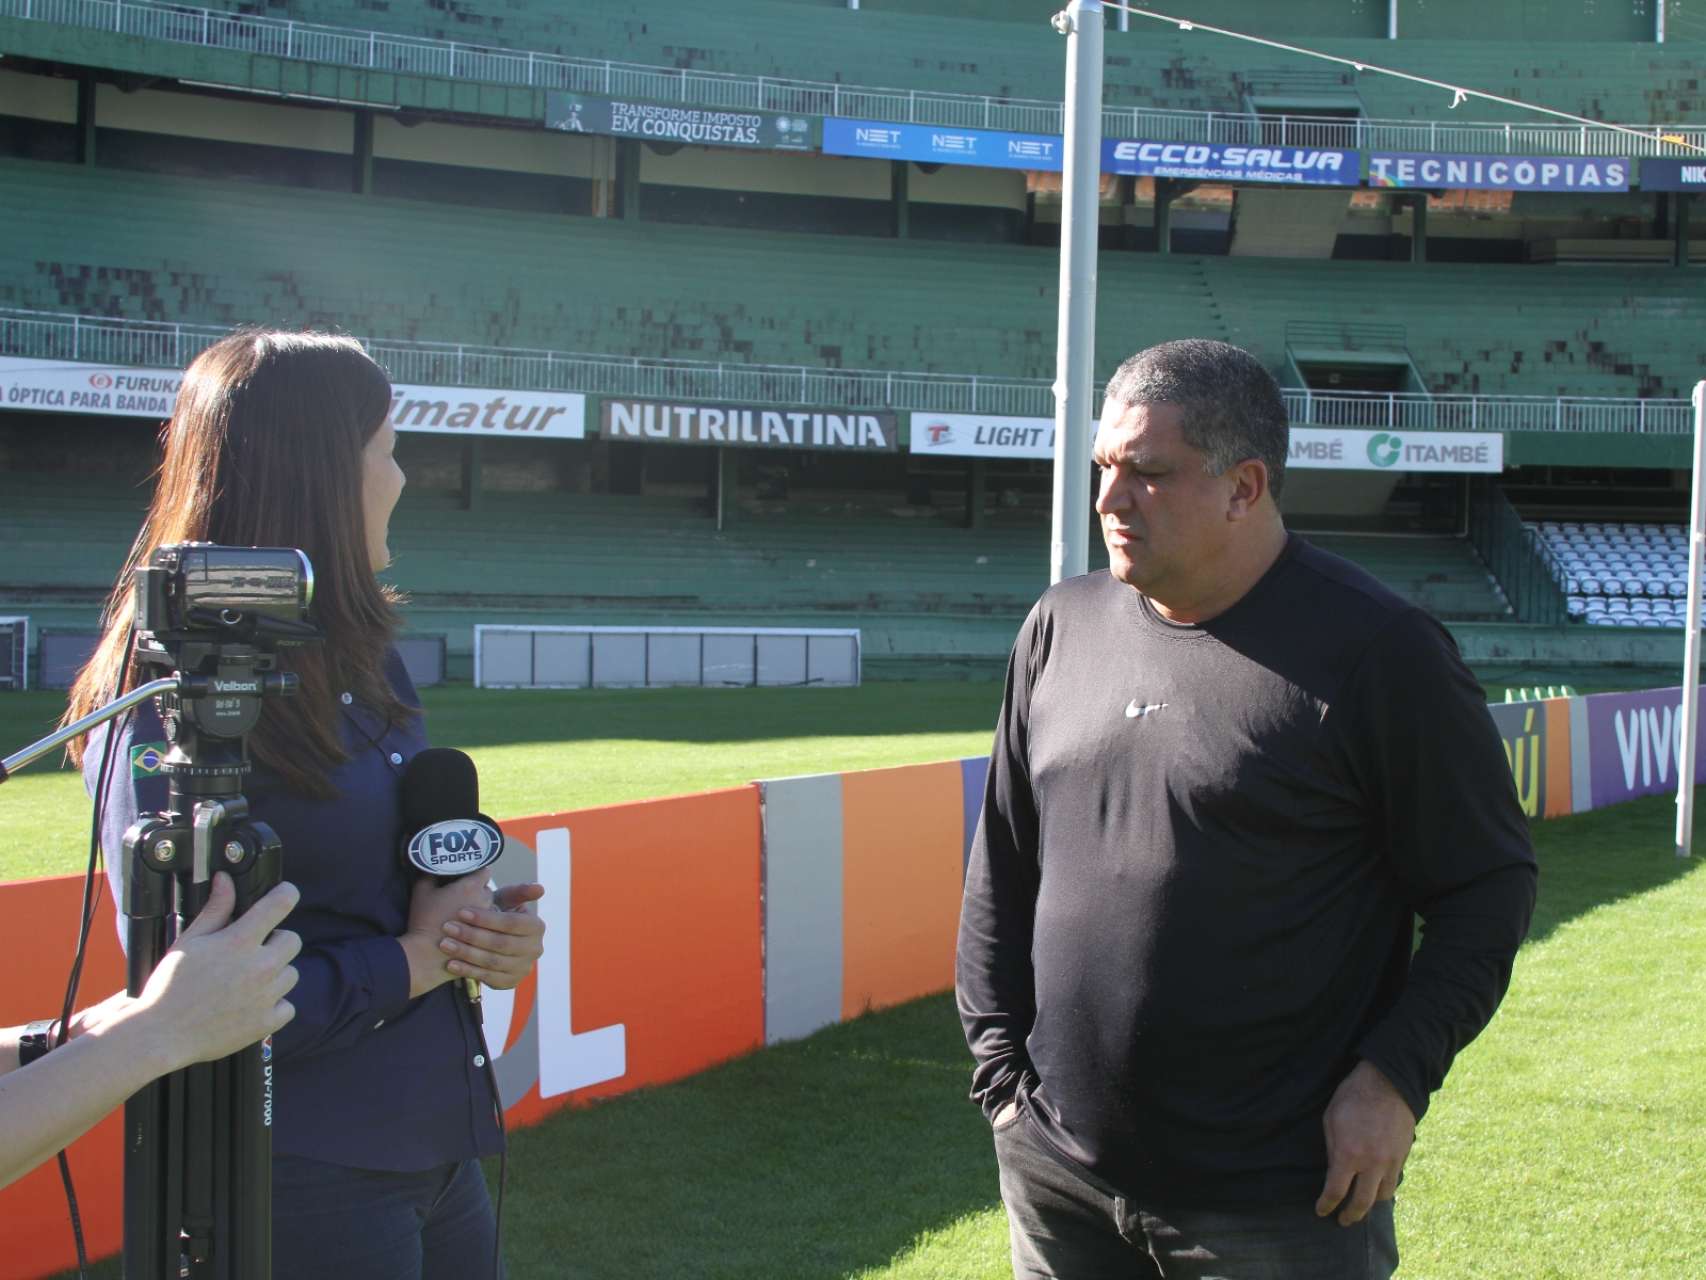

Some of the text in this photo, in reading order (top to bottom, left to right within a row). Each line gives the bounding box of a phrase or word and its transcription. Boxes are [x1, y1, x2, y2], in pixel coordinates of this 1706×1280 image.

[611, 102, 761, 128] TRANSFORME IMPOSTO
[611, 115, 638, 133] EM
[642, 119, 760, 144] CONQUISTAS.
[856, 128, 901, 143] NET
[932, 134, 977, 149] NET
[1008, 140, 1053, 156] NET
[8, 383, 65, 405] ÓPTICA
[70, 391, 112, 409] PARA
[116, 394, 167, 412] BANDA
[610, 402, 887, 448] NUTRILATINA
[974, 426, 1044, 447] LIGHT
[1405, 444, 1489, 464] ITAMBÉ
[214, 680, 257, 692] Velbon
[428, 829, 480, 855] FOX
[430, 851, 483, 865] SPORTS
